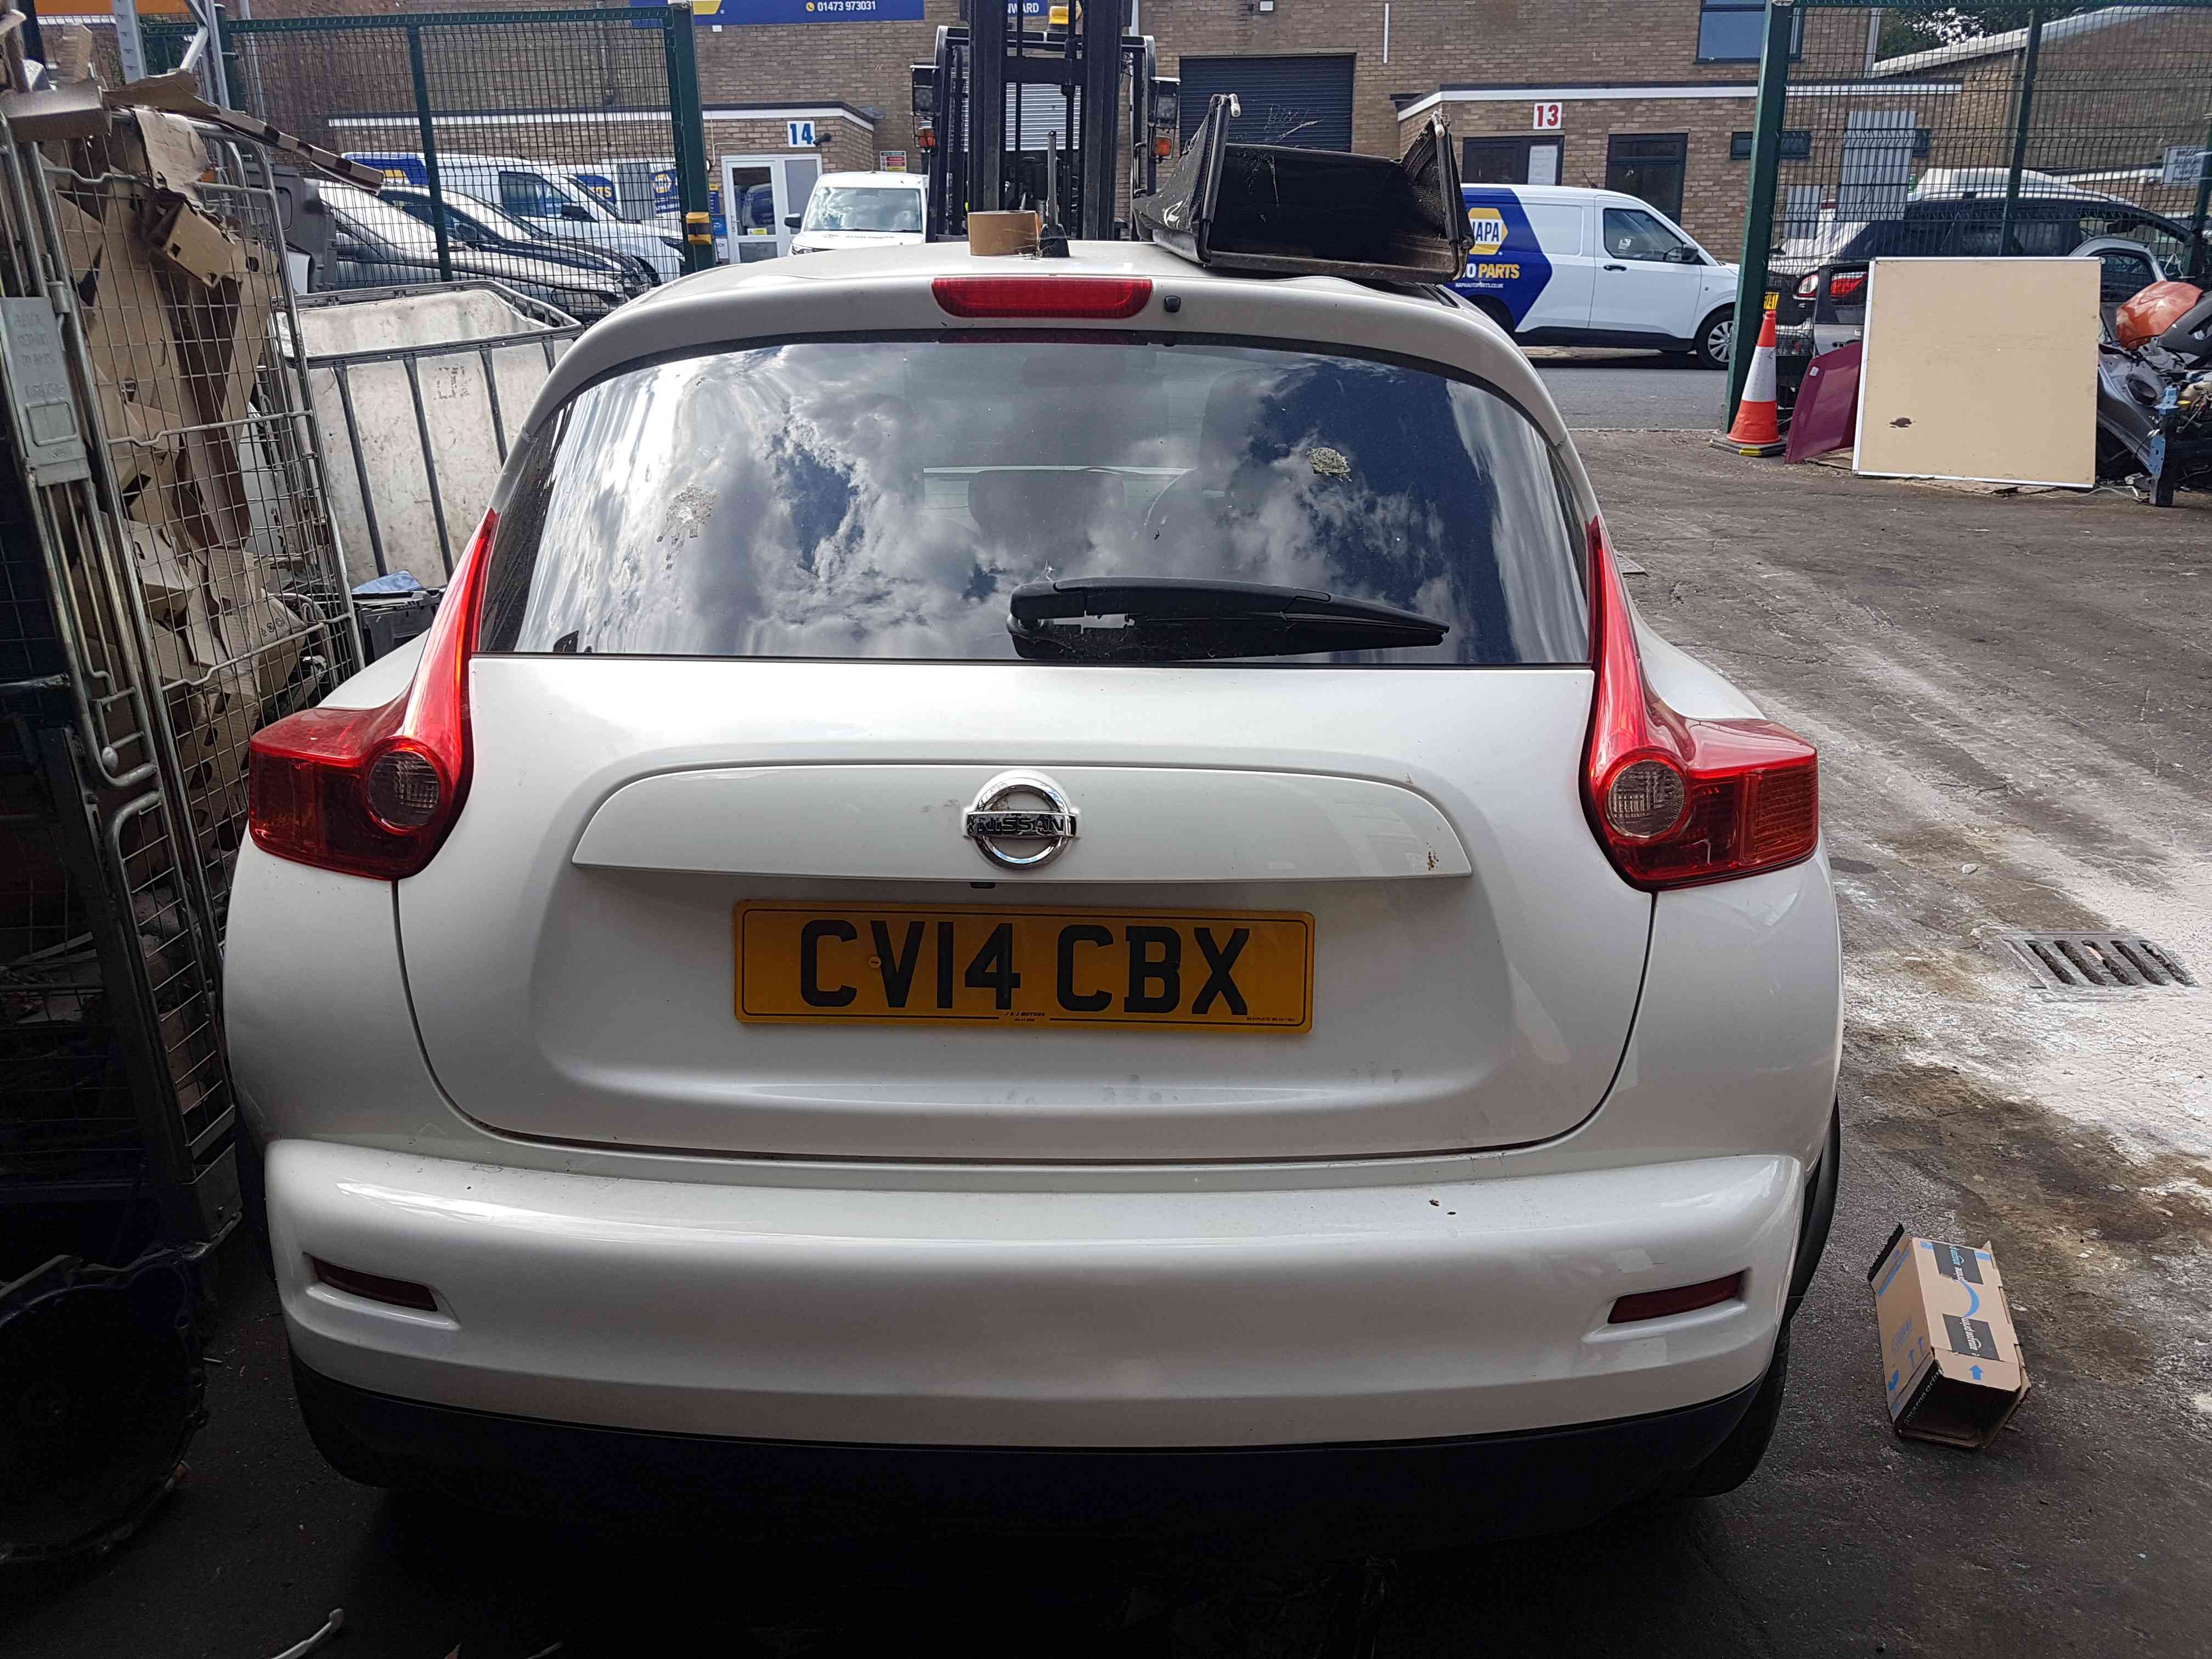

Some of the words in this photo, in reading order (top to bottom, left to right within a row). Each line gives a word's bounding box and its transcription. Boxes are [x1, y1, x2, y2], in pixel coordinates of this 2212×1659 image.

[817, 2, 843, 12] 01473
[845, 1, 876, 10] 973031
[1537, 105, 1559, 127] 13
[790, 123, 813, 145] 14
[1478, 263, 1521, 279] PARTS
[978, 816, 1064, 834] NISSAN
[800, 919, 1022, 1010] CV14
[1057, 924, 1250, 1016] CBX
[1959, 1317, 1976, 1332] prim
